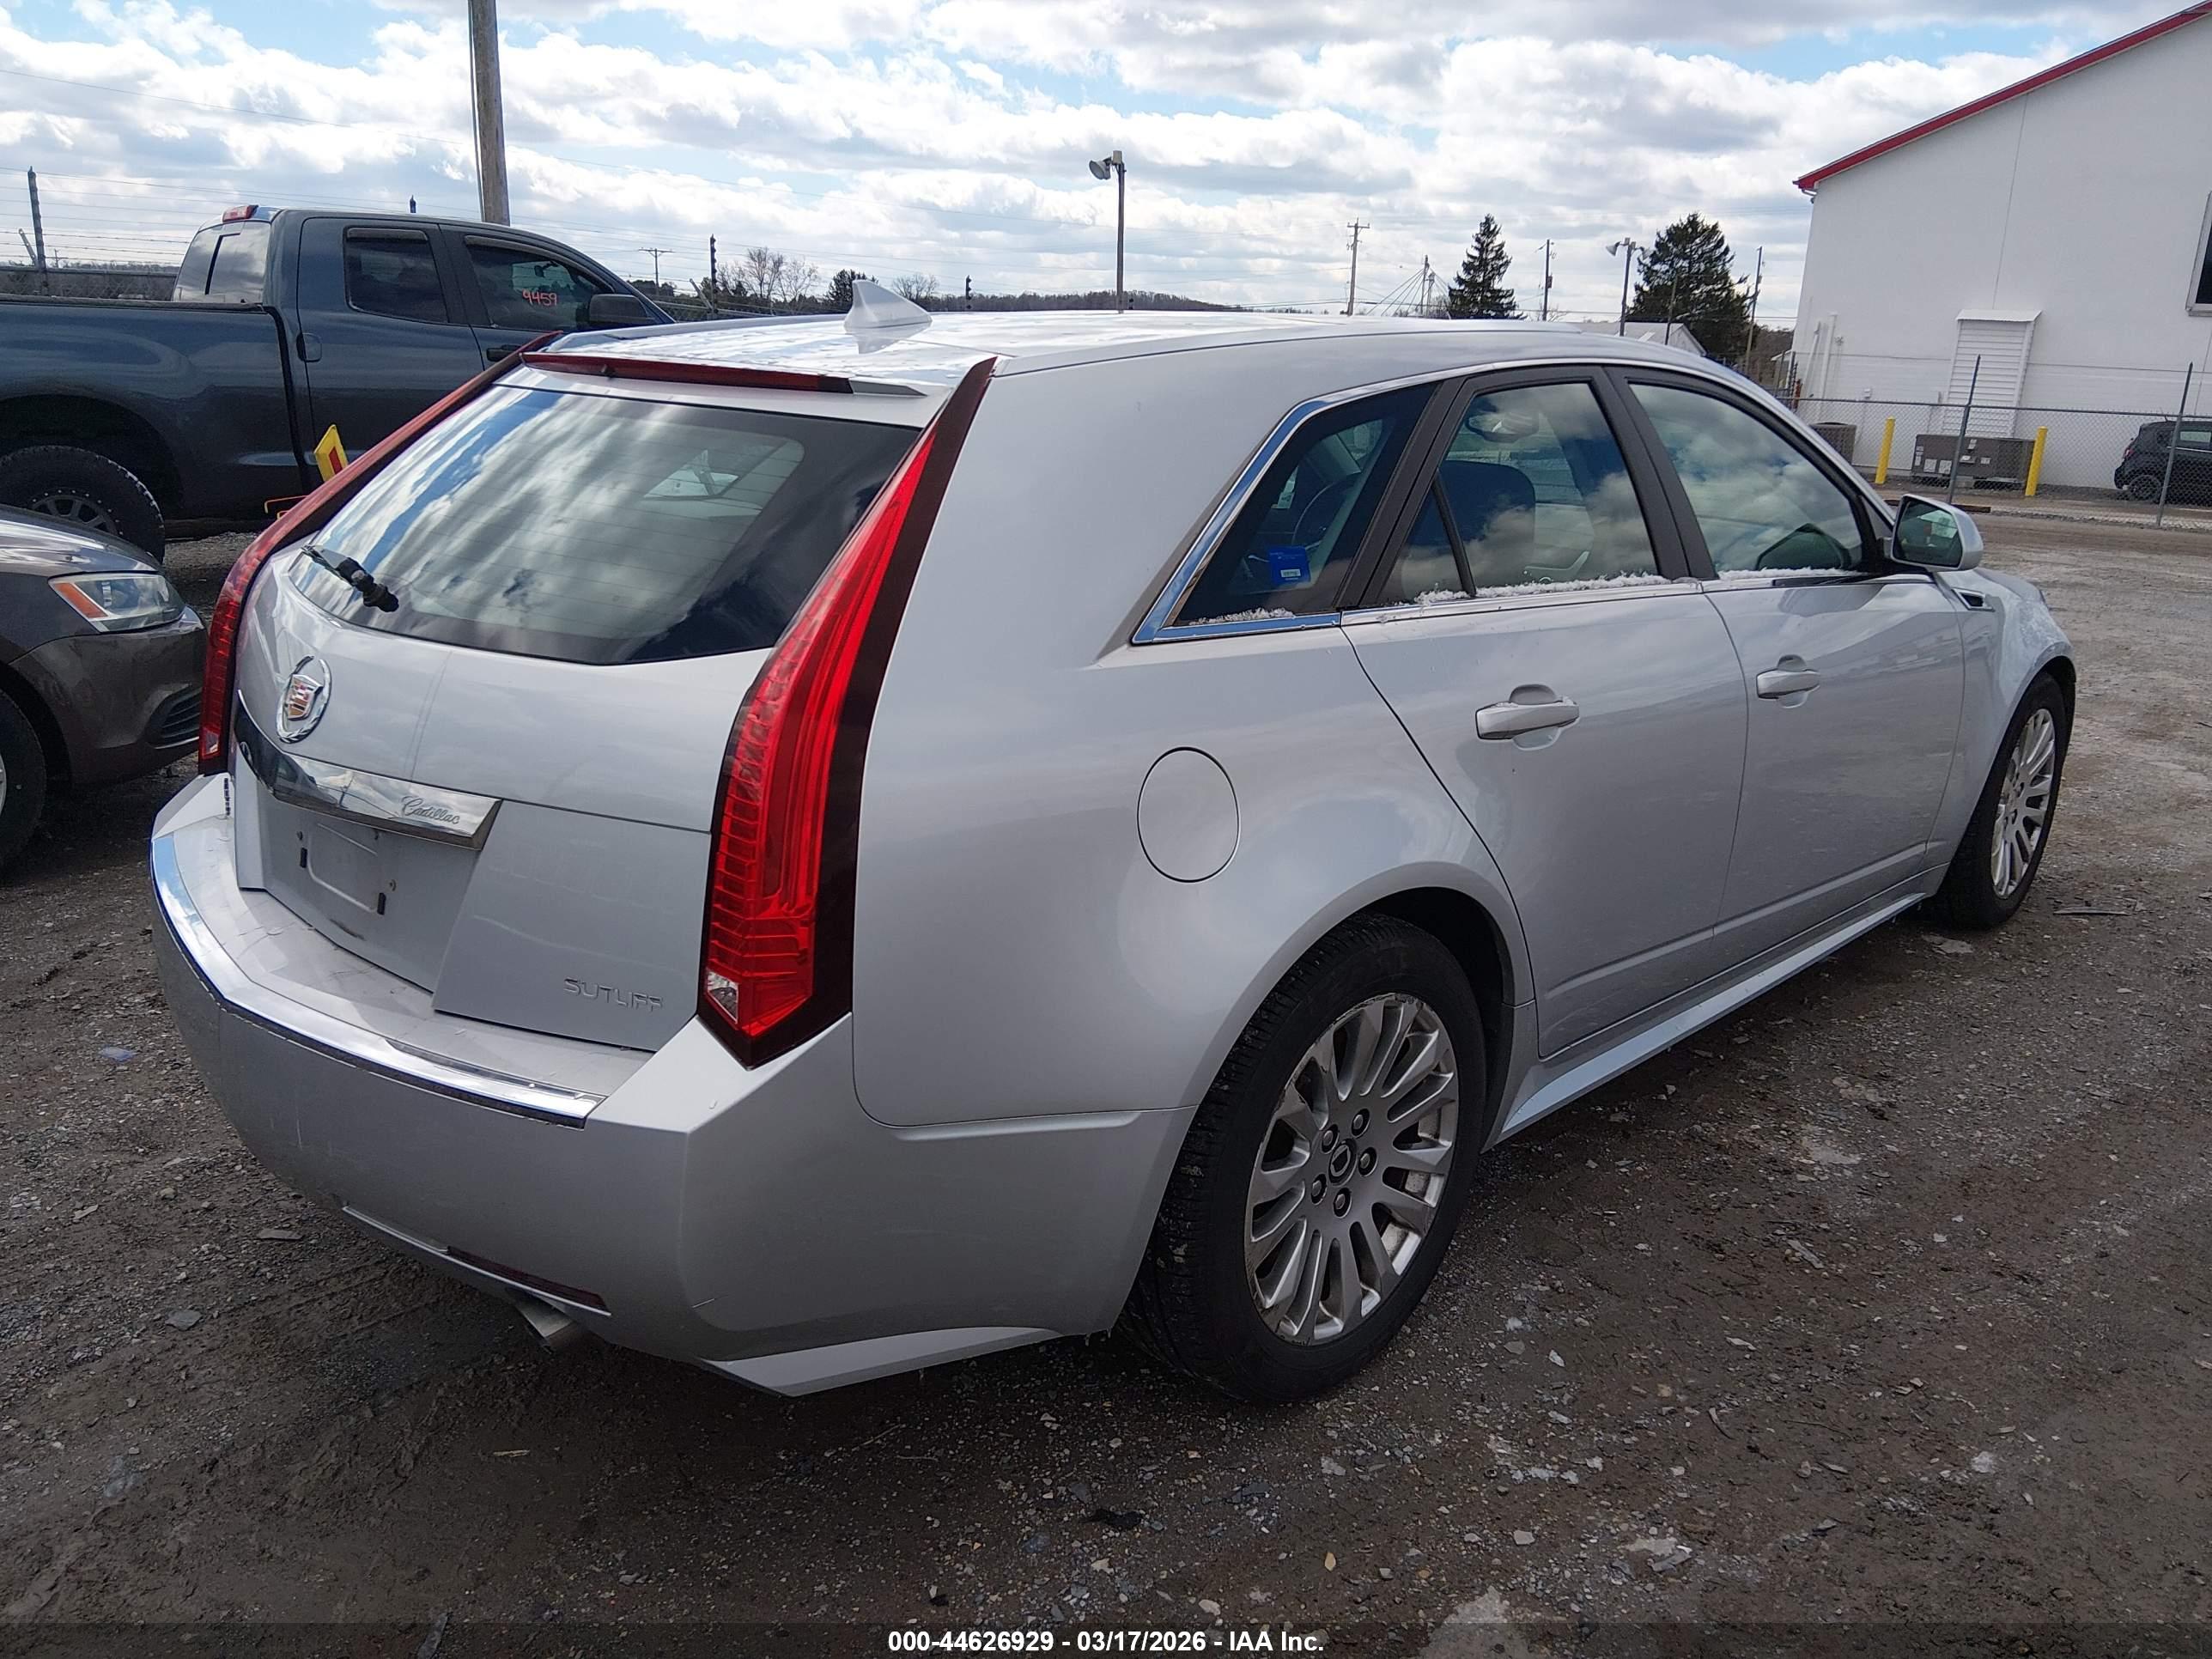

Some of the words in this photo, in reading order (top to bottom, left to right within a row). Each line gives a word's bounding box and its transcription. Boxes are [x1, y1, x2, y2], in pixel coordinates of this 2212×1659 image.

[522, 288, 557, 307] 9459
[401, 795, 460, 825] Cadillac
[563, 976, 664, 1013] SUTLIFF
